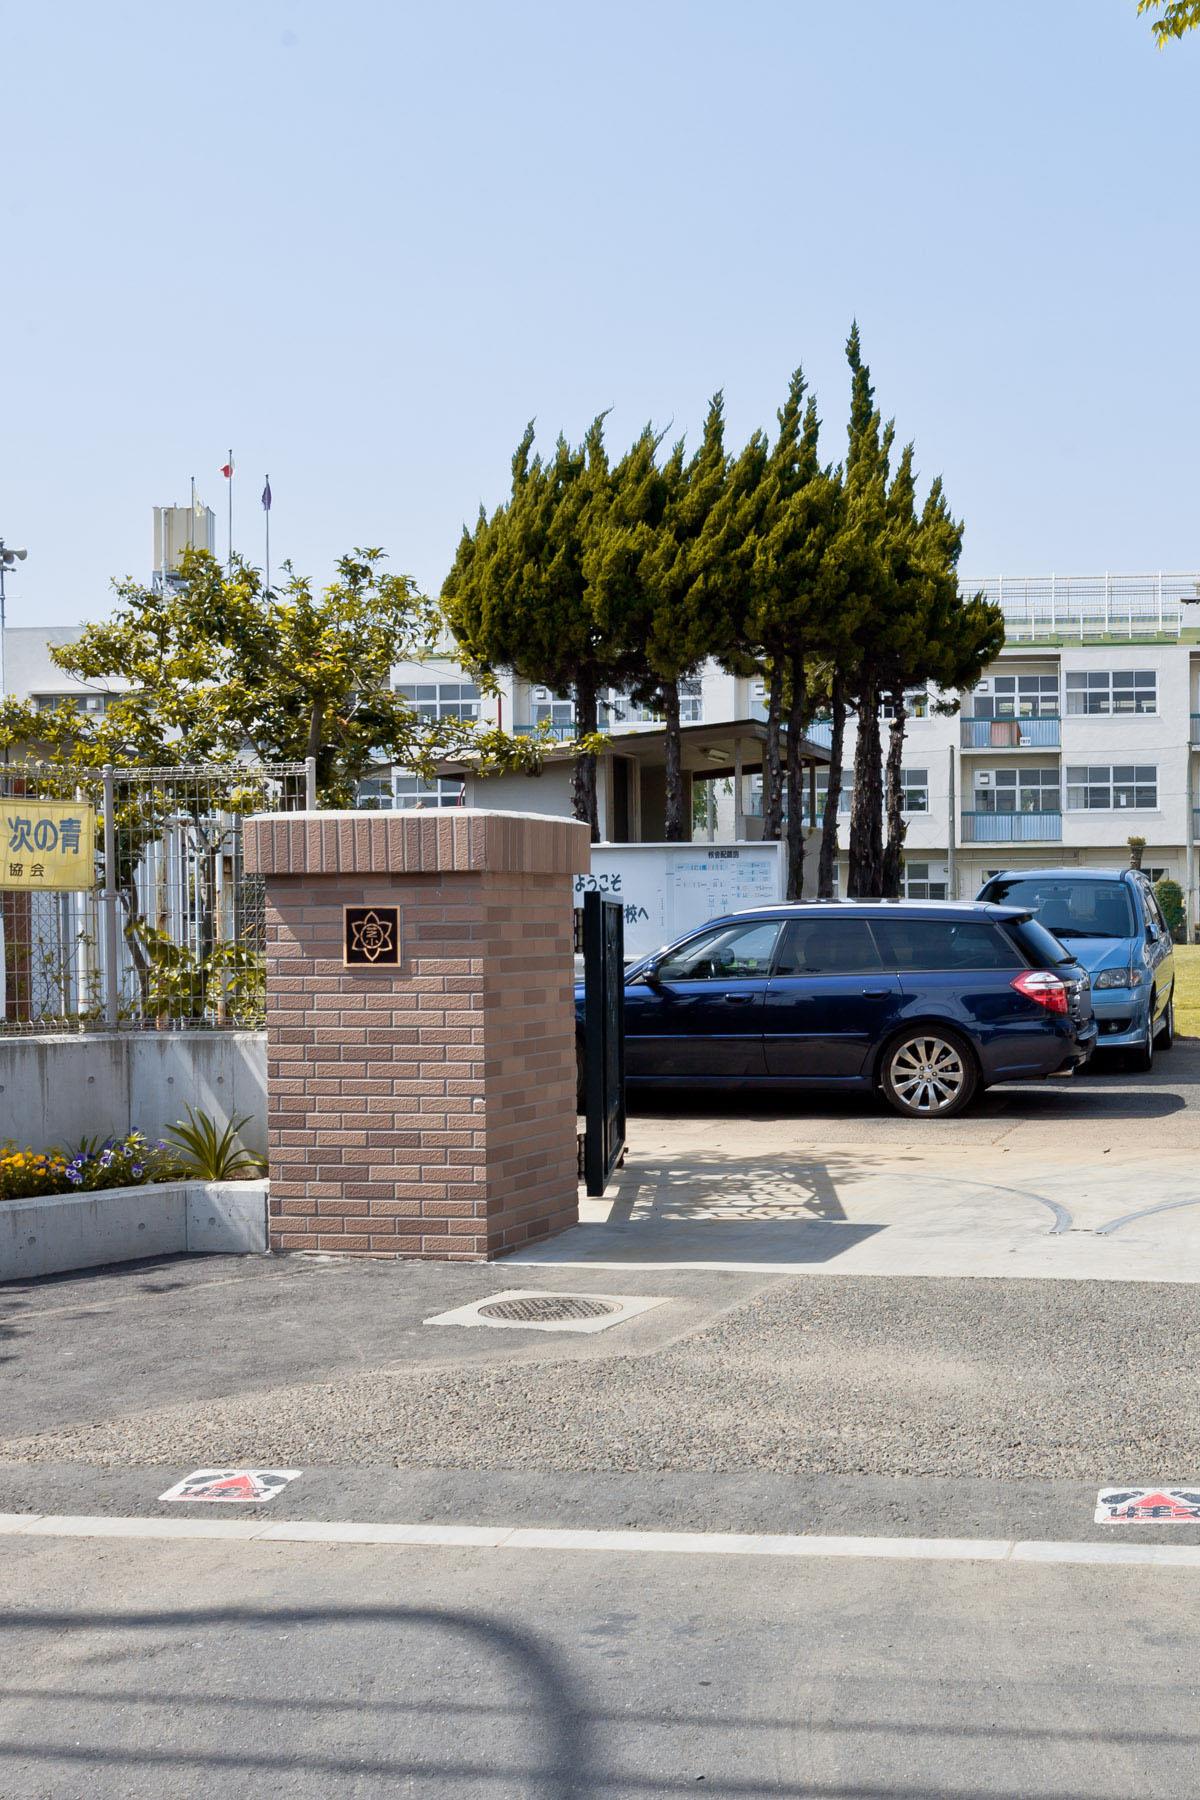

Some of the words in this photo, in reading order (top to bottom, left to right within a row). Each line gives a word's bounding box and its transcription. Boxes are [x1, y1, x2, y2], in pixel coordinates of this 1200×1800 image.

[8, 816, 81, 855] 次の青
[9, 863, 45, 878] 協会
[575, 874, 622, 893] ようこそ
